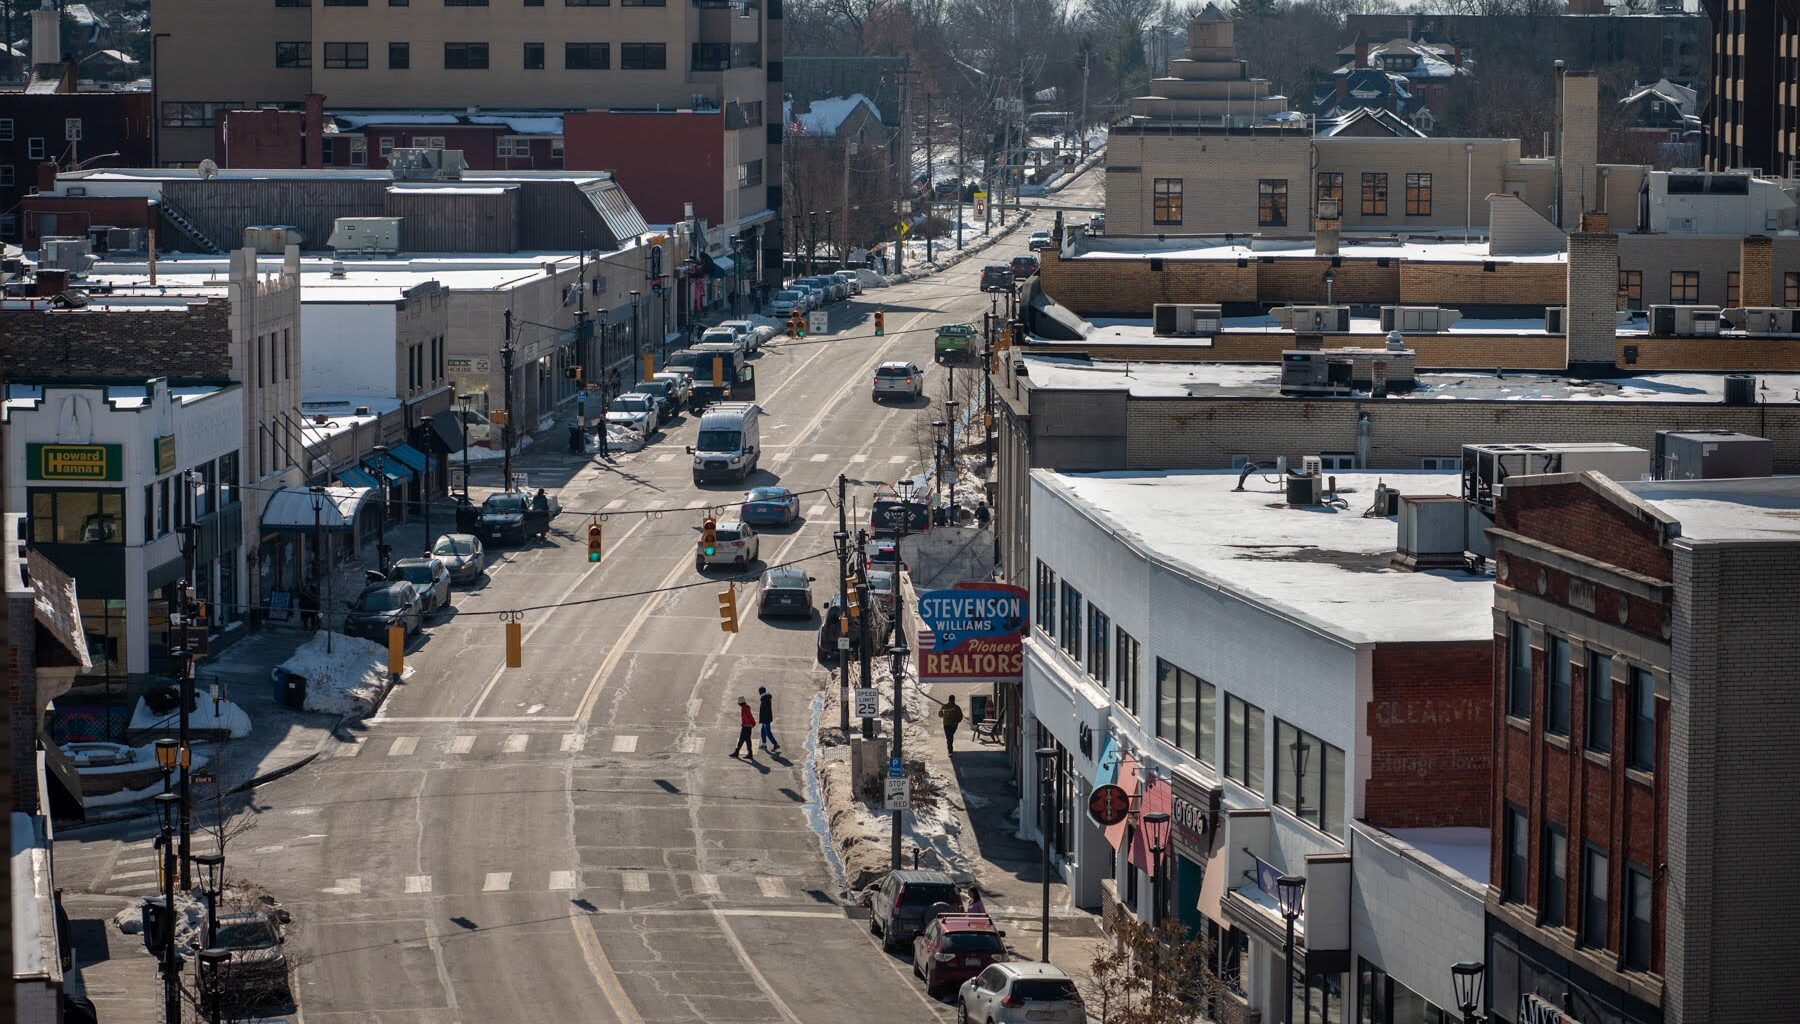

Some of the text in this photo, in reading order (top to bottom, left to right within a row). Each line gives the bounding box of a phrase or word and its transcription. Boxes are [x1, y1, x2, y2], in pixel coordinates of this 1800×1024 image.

[49, 451, 100, 463] Howard
[49, 461, 95, 473] Hanna
[922, 598, 1020, 618] STEVENSON
[936, 620, 992, 631] WILLIAMS
[942, 633, 957, 641] CO.
[968, 639, 1020, 653] Pioneer
[927, 654, 1023, 674] REALTORS
[858, 703, 877, 715] 25
[892, 759, 899, 767] P
